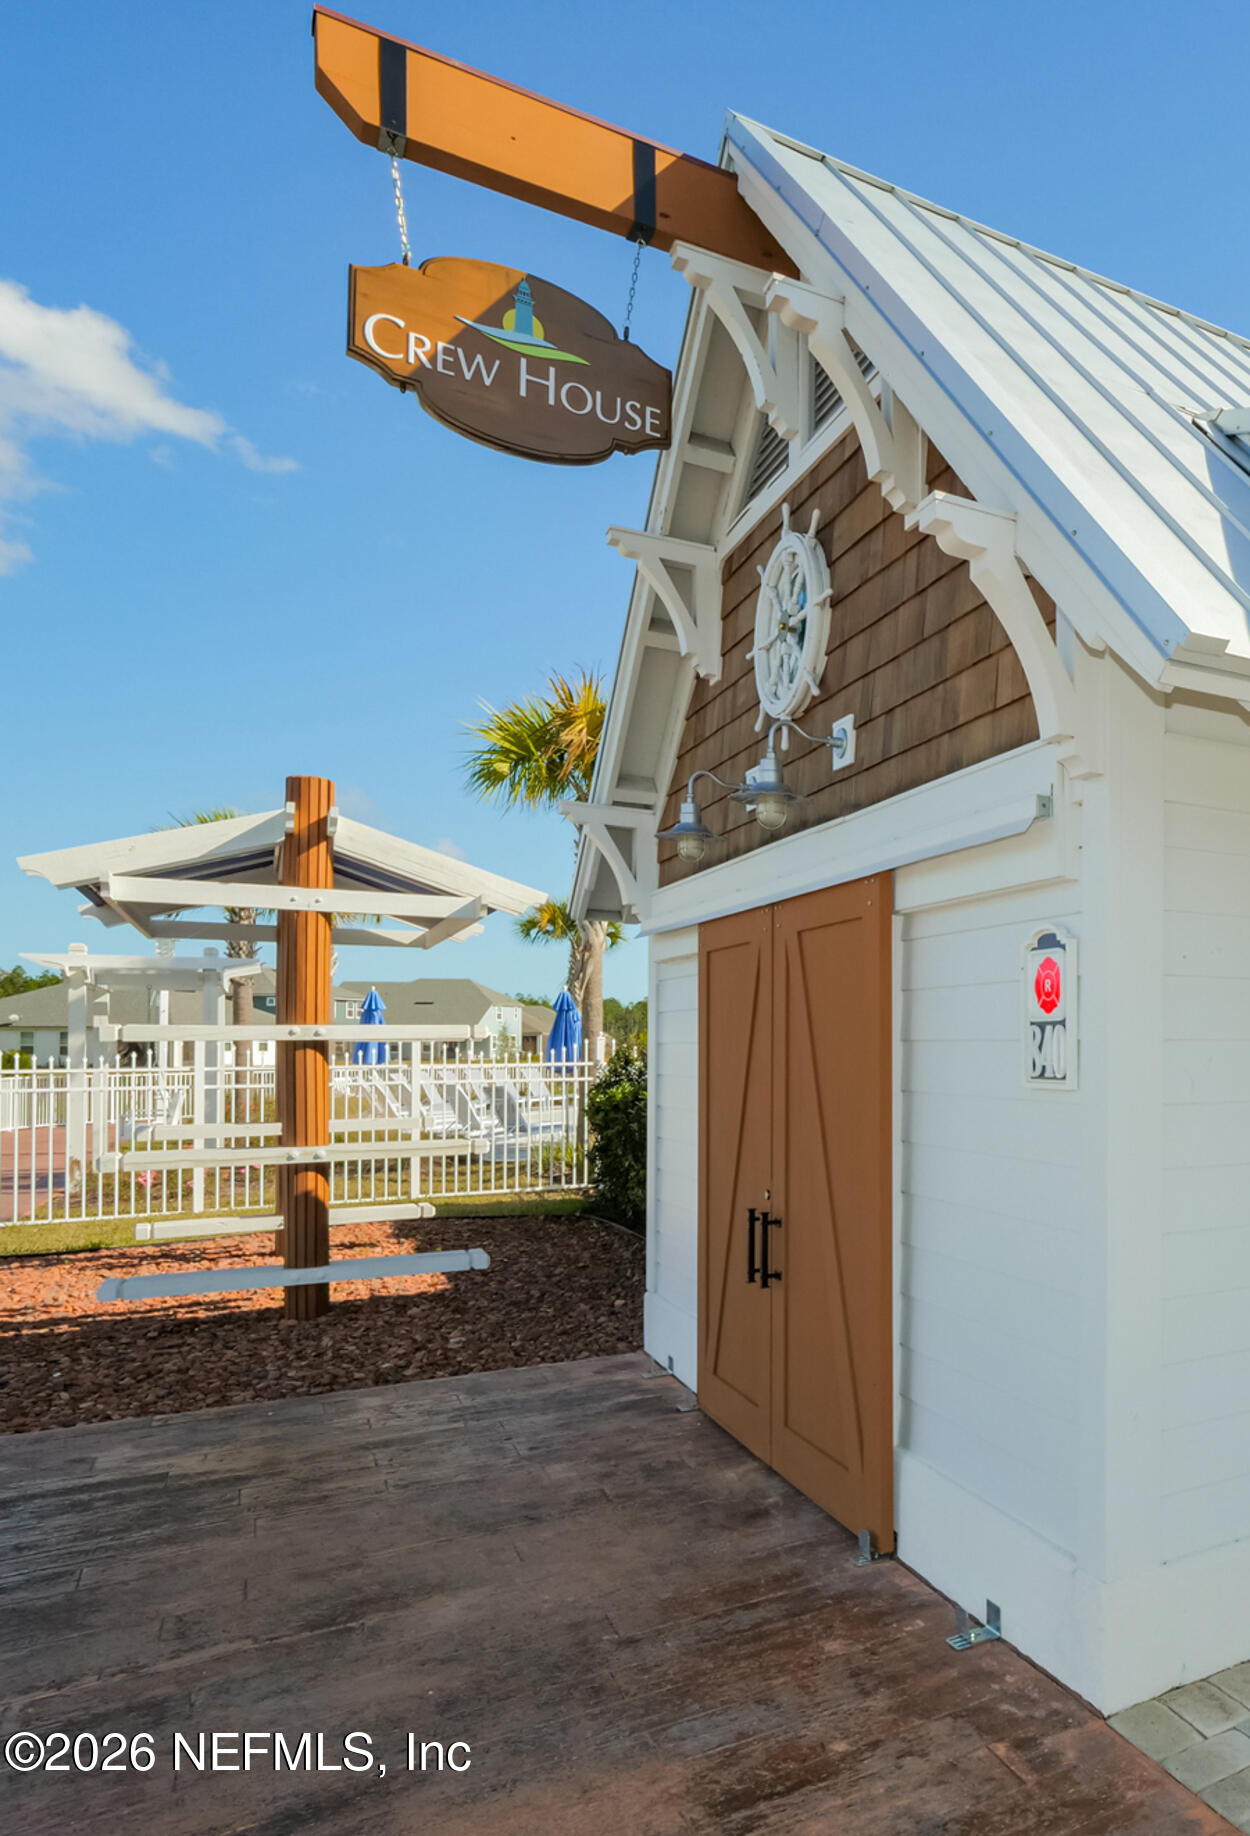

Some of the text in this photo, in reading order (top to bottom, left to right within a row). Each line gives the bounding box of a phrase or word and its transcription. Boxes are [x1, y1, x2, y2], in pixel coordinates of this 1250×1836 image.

[363, 312, 661, 437] CREW HOUSE
[1044, 978, 1051, 992] R
